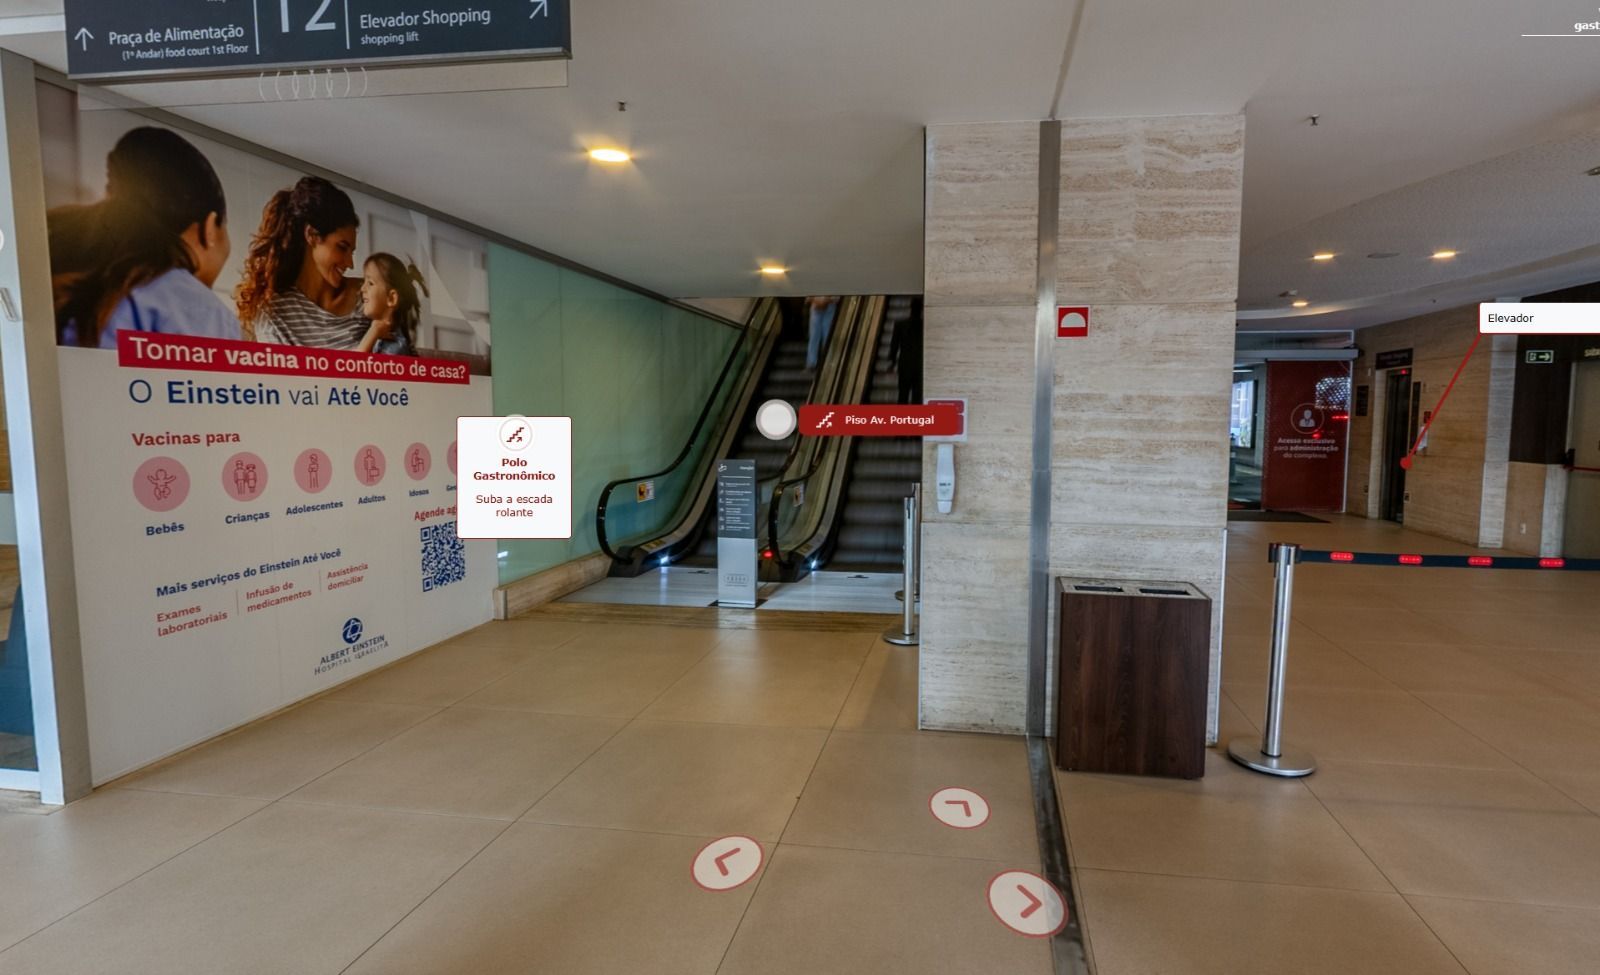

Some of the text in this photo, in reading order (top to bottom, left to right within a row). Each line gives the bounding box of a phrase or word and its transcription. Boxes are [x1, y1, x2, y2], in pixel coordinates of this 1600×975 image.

[360, 8, 490, 29] Elevador Shopping
[109, 24, 244, 47] Praça de Alimentação
[361, 32, 419, 45] shopping lift
[136, 48, 164, 60] Andar)
[165, 47, 185, 58] food
[187, 46, 209, 57] court
[212, 45, 225, 55] 1st
[226, 44, 248, 54] Floor
[129, 336, 466, 379] Tomar vacina no conforto de casa?
[129, 379, 409, 406] O Einstein vai Até Você
[132, 432, 241, 447] Vacinas para
[286, 501, 344, 515] Adolescentes
[358, 495, 386, 505] Adultos
[225, 511, 270, 525] Crianças
[415, 506, 445, 521] Agende
[146, 522, 185, 536] Bebês
[156, 548, 341, 597] Mais serviços do Einstein Até Você
[327, 562, 369, 579] Assistência
[246, 581, 294, 600] Infusão de
[328, 575, 364, 591] domiciliar
[247, 590, 312, 613] medicamentos
[157, 605, 202, 623] Exames
[158, 612, 228, 637] laboratoriais
[320, 634, 385, 665] ALBERT EINSTEIN
